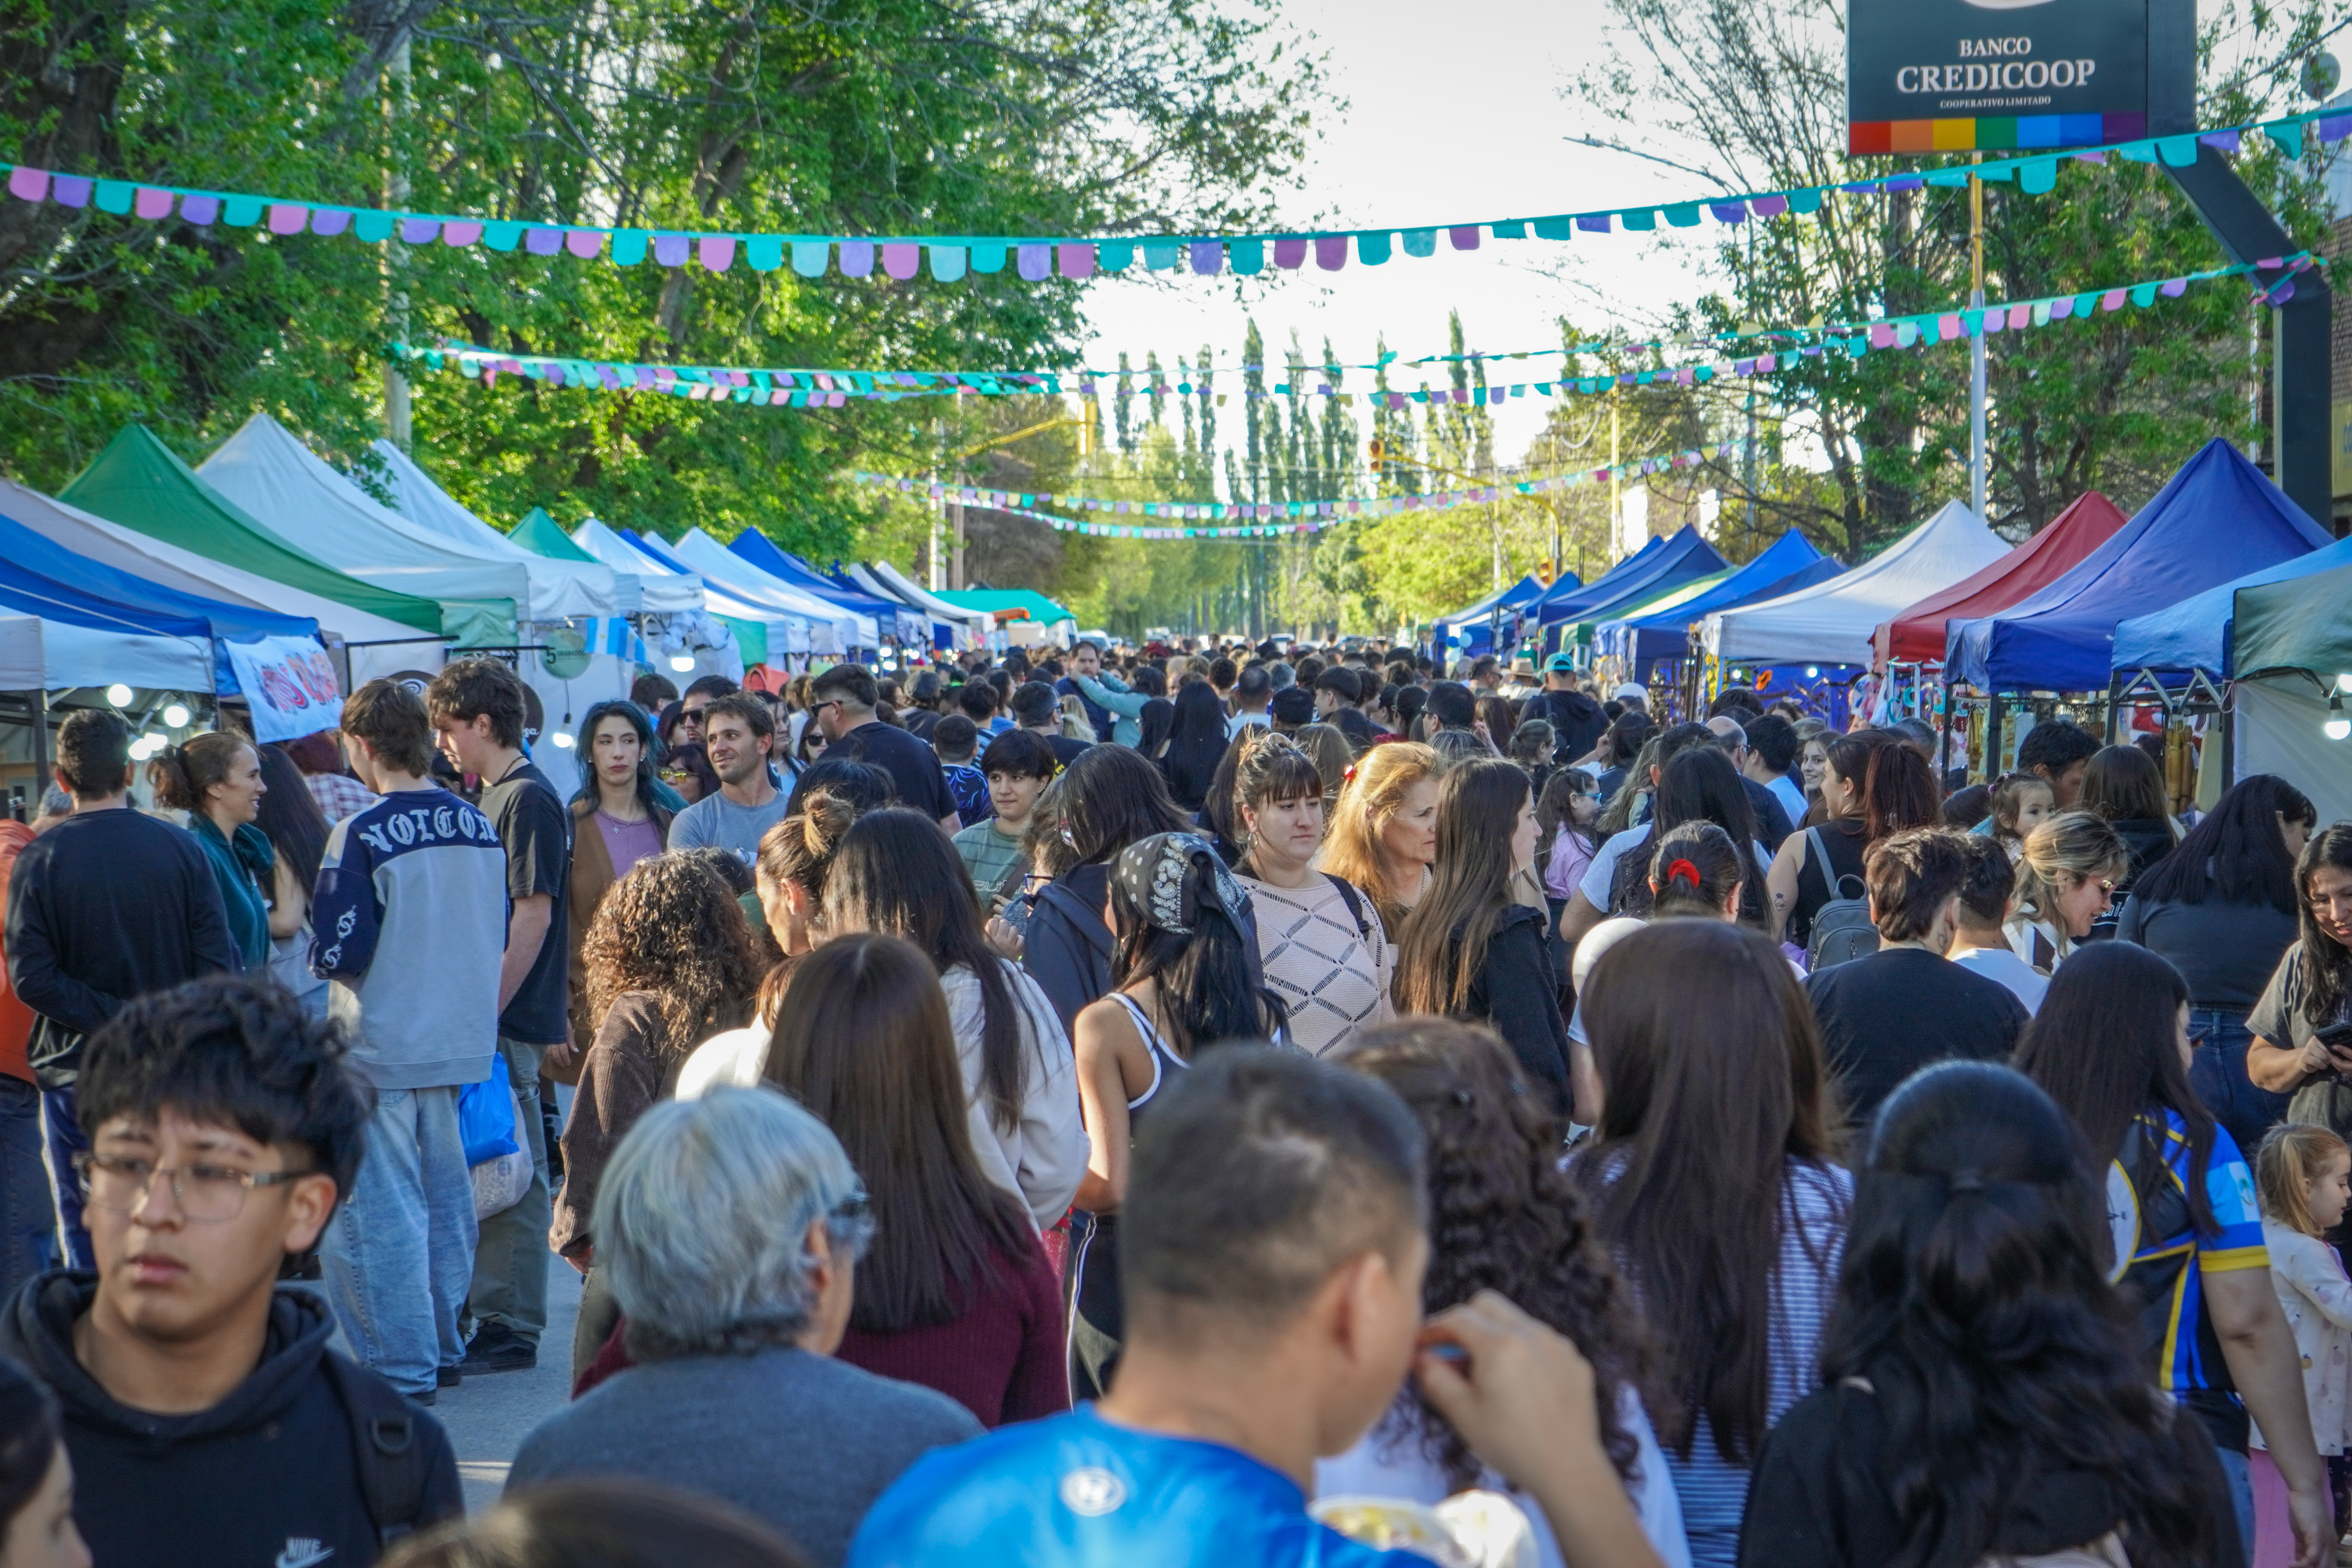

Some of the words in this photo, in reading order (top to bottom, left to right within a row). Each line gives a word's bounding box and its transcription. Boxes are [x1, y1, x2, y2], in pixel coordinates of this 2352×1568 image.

[1960, 37, 2032, 58] BANCO
[1896, 59, 2096, 93] CREDICOOP
[1940, 98, 2004, 109] COOPERATIVO
[2005, 95, 2051, 107] LIMITADO
[286, 1537, 321, 1557] NIKE
